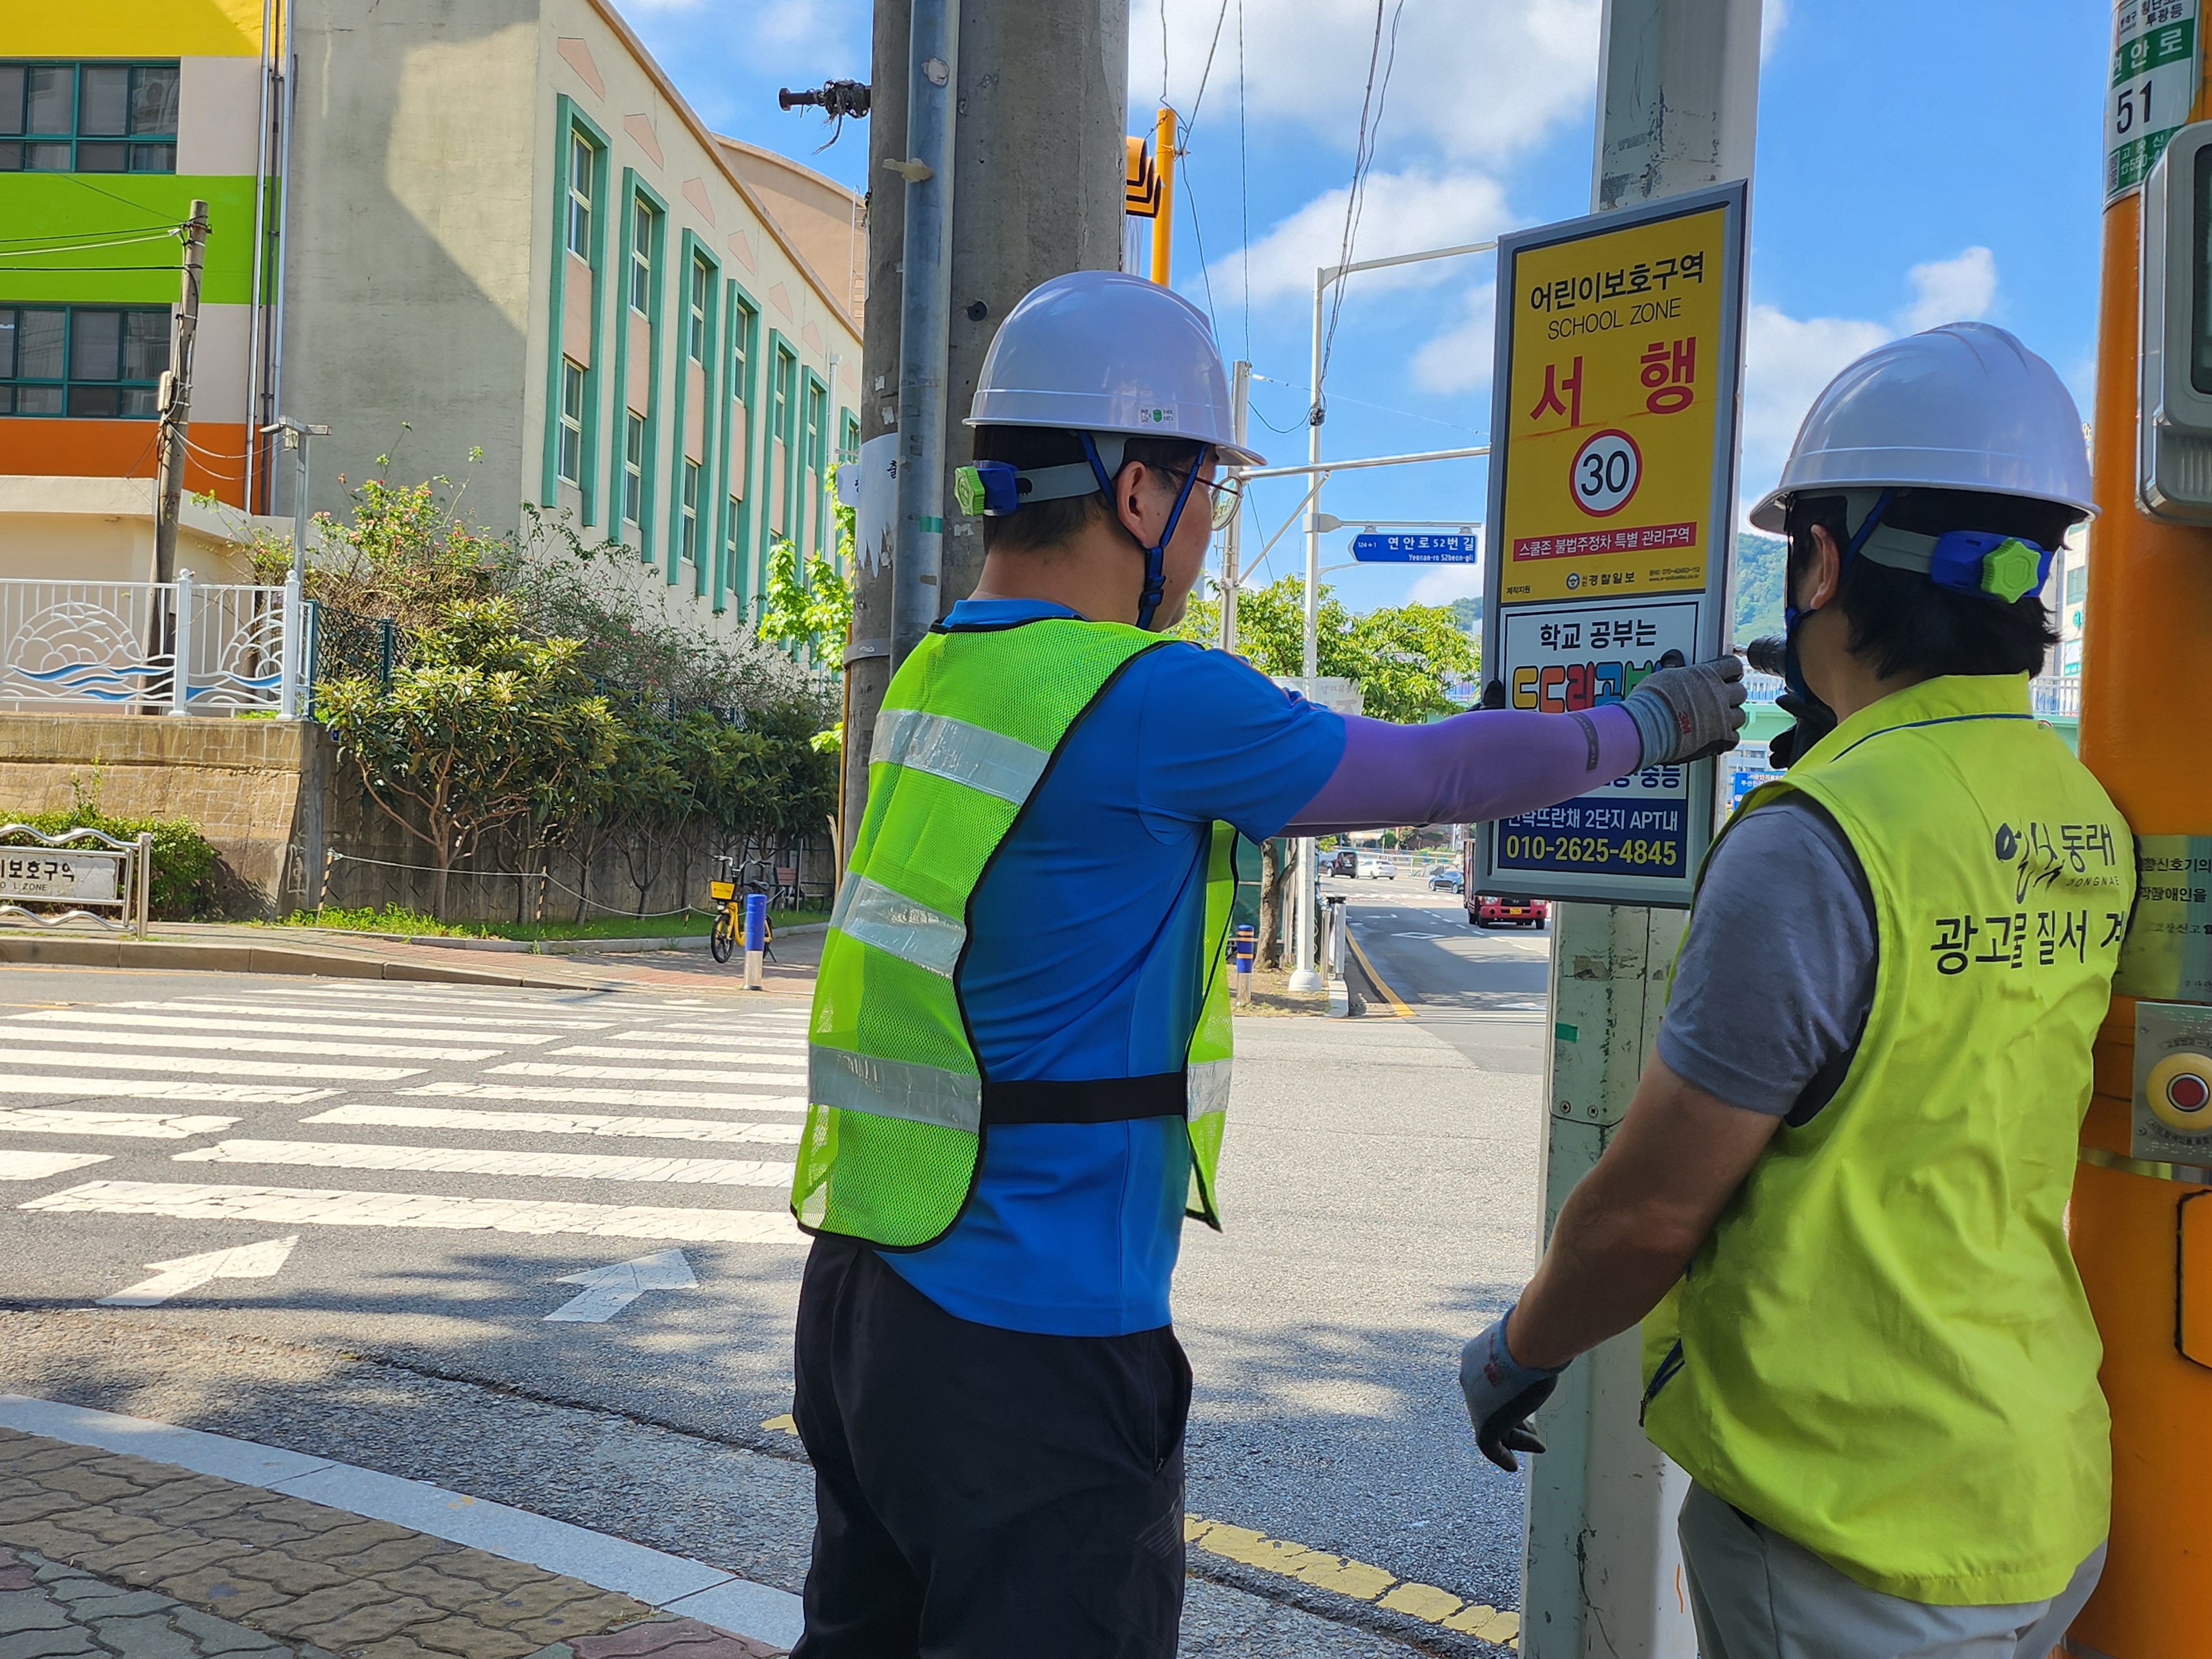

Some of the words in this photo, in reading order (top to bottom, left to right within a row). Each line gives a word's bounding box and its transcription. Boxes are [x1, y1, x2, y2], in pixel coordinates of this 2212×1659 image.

[2146, 3, 2183, 27] 투광등
[2116, 80, 2153, 134] 51
[1531, 251, 1704, 312] 어린이보호구역
[1548, 310, 1624, 340] SCHOOL
[1630, 298, 1682, 325] ZONE
[1581, 451, 1630, 496] 30
[1519, 540, 1552, 556] 스쿨존
[1555, 535, 1611, 554] 불법주정차
[1614, 531, 1639, 549] 특별
[1642, 526, 1690, 546] 관리구역
[1441, 554, 1474, 562] 52beon-gil
[1541, 623, 1581, 651] 학교
[1590, 619, 1657, 649] 공부는
[1585, 808, 1626, 830] 2단지
[1630, 810, 1678, 831] APT내
[1506, 835, 1677, 865] 010-2625-4845
[2062, 823, 2115, 873] 동래
[23, 883, 48, 891] ZONE
[2067, 876, 2120, 887] DONGNAE
